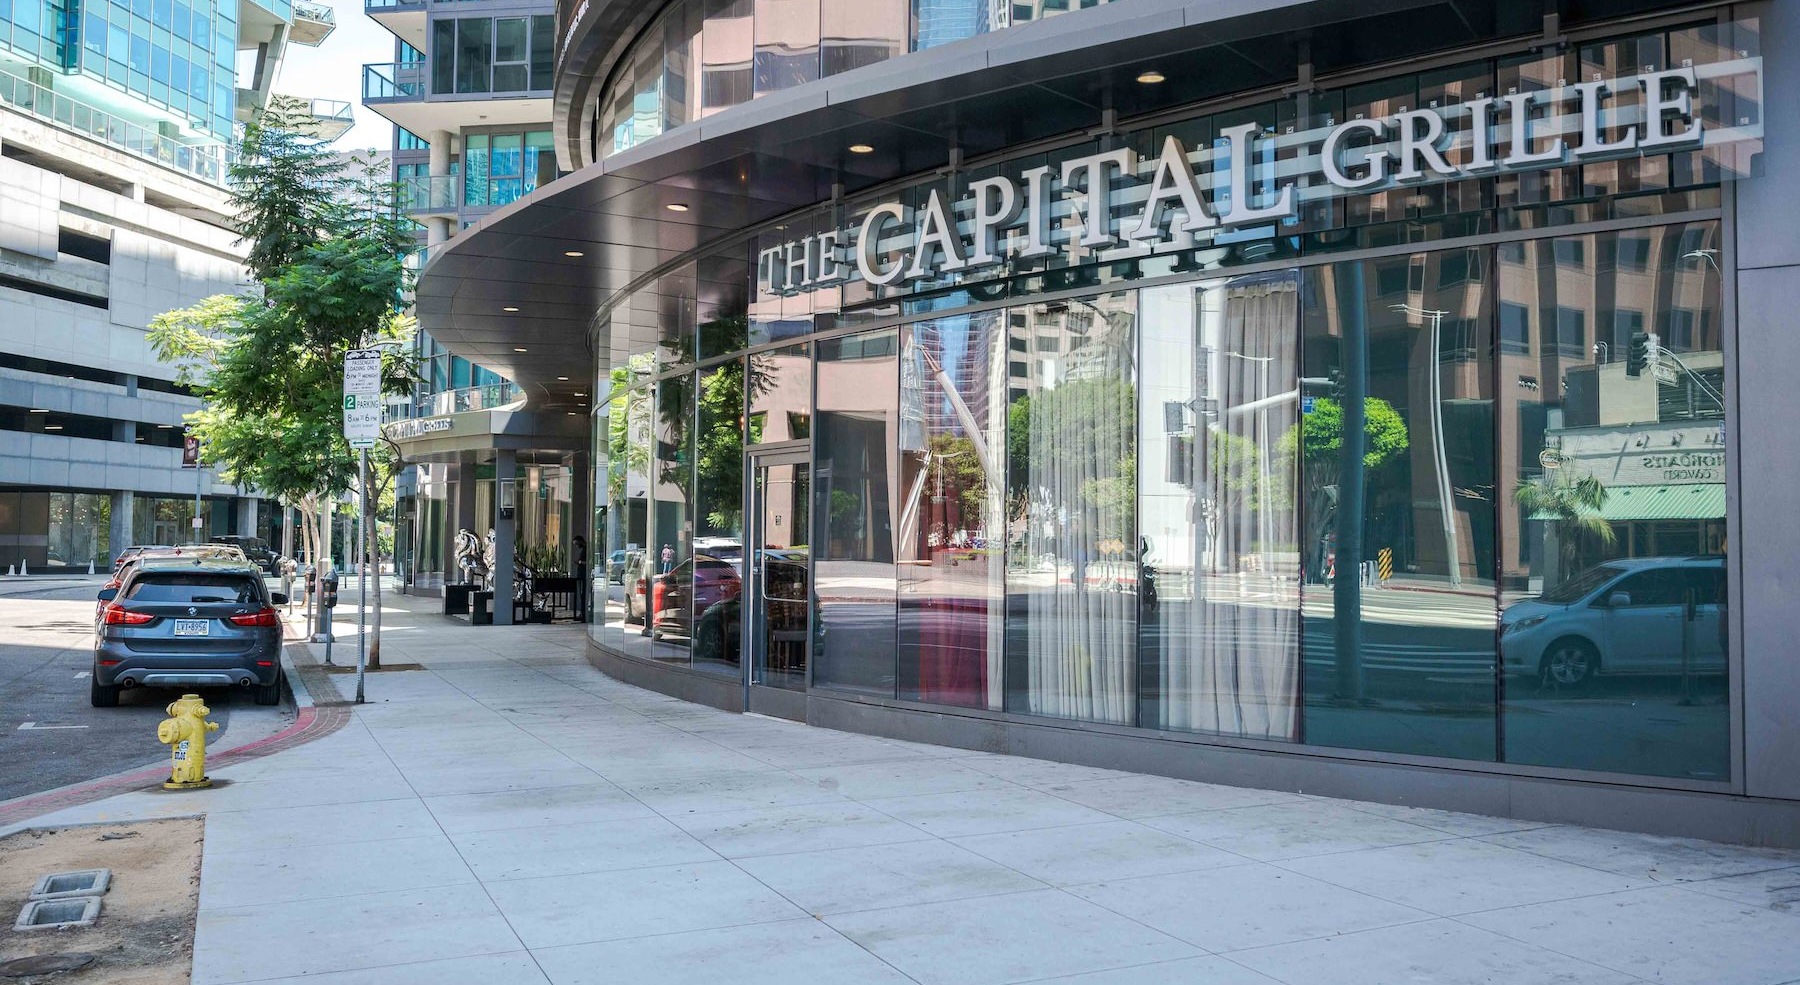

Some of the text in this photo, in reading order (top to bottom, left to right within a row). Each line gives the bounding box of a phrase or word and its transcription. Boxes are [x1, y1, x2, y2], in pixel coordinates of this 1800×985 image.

[759, 66, 1703, 297] THE CAPITAL GRILLE
[347, 396, 379, 409] 2 PARKING
